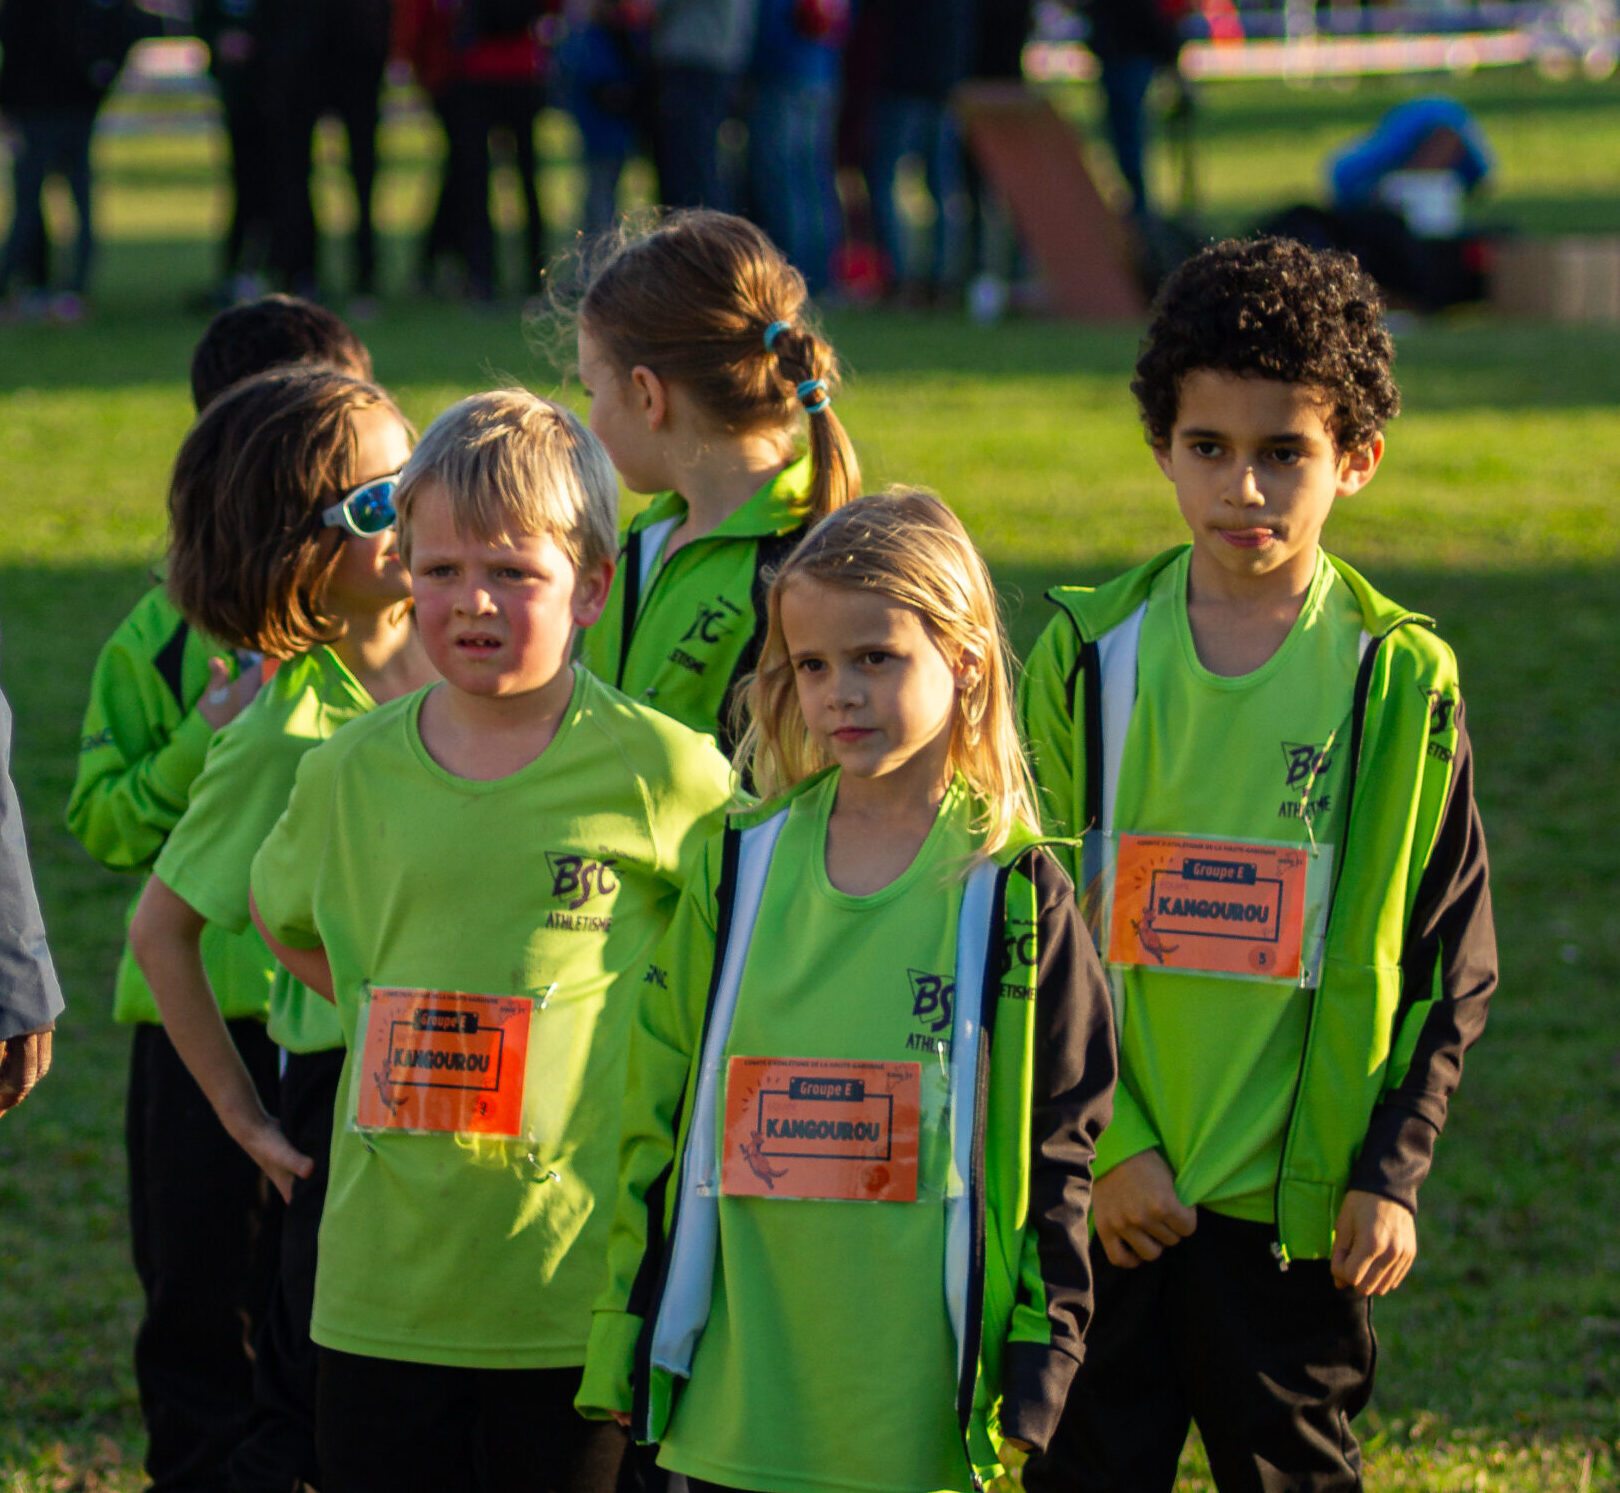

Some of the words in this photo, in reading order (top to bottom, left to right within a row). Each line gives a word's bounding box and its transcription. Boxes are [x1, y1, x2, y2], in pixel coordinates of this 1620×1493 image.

[1193, 863, 1234, 879] Groupe
[1237, 866, 1244, 878] E
[552, 856, 618, 910] BSC
[1158, 896, 1269, 923] KANGOUROU
[545, 911, 612, 932] ATHLETISME
[1258, 951, 1267, 965] 5
[421, 1013, 457, 1030] Groupe
[393, 1048, 490, 1073] KANGOUROU
[800, 1081, 841, 1098] Groupe
[845, 1083, 852, 1095] E
[766, 1118, 880, 1142] KANGOUROU
